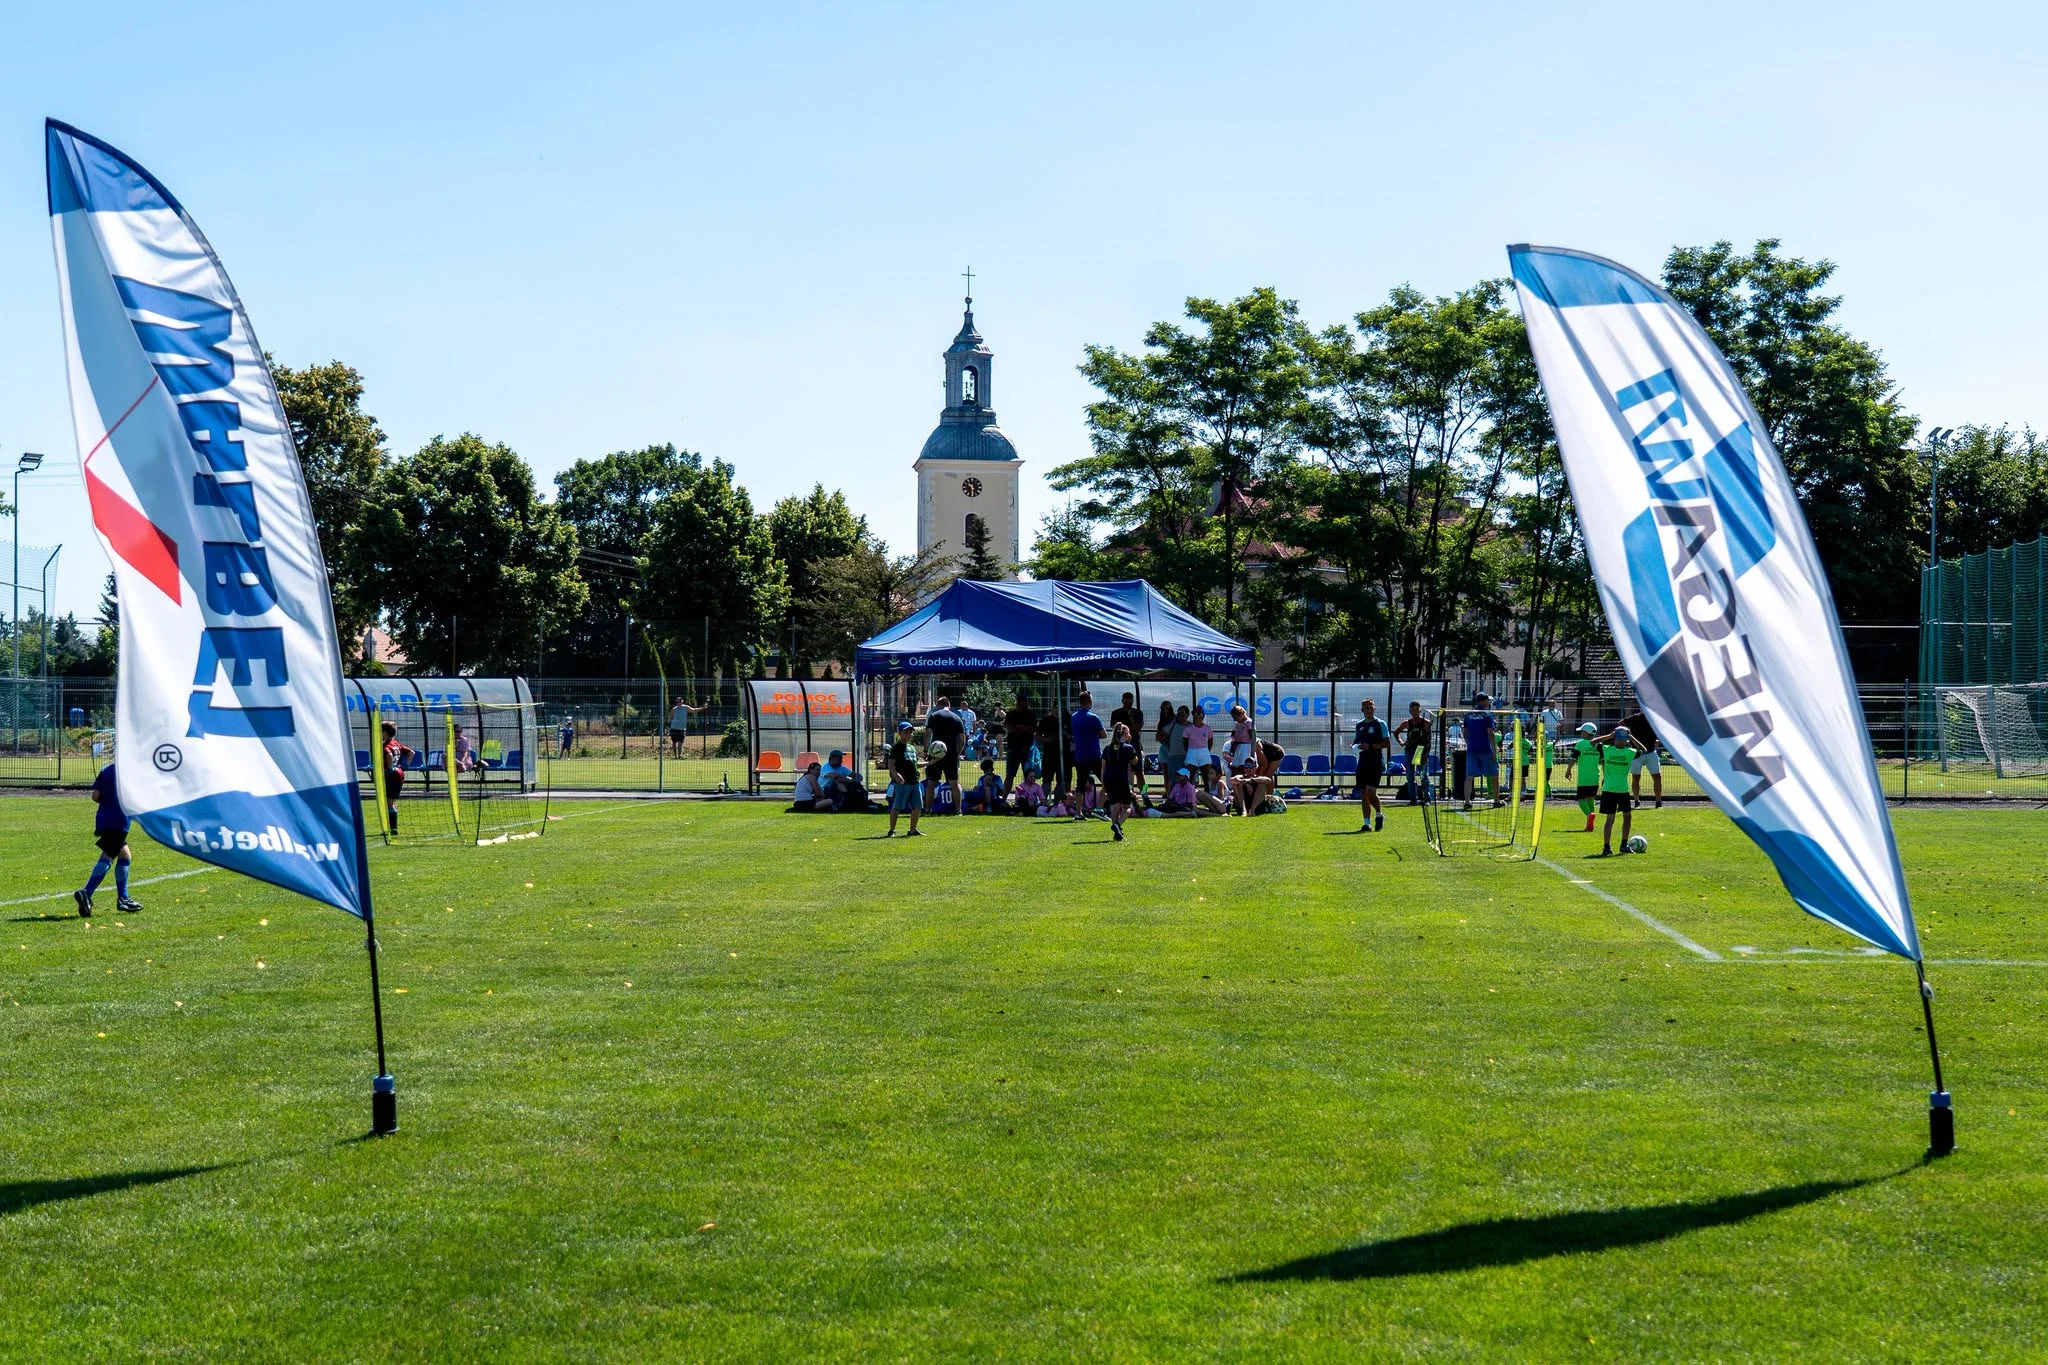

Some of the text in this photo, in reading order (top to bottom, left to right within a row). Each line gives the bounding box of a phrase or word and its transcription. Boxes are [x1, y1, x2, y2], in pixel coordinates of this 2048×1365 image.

[909, 655, 955, 667] Ośrodek
[1000, 657, 1034, 669] Sportu
[1107, 648, 1153, 660] Lokalnej
[1156, 649, 1165, 658] w
[1167, 650, 1215, 665] Miejskiej
[1218, 654, 1253, 667] Górce
[773, 691, 838, 703] POMOC
[1198, 693, 1329, 716] GOŚCIE
[940, 789, 953, 804] 10
